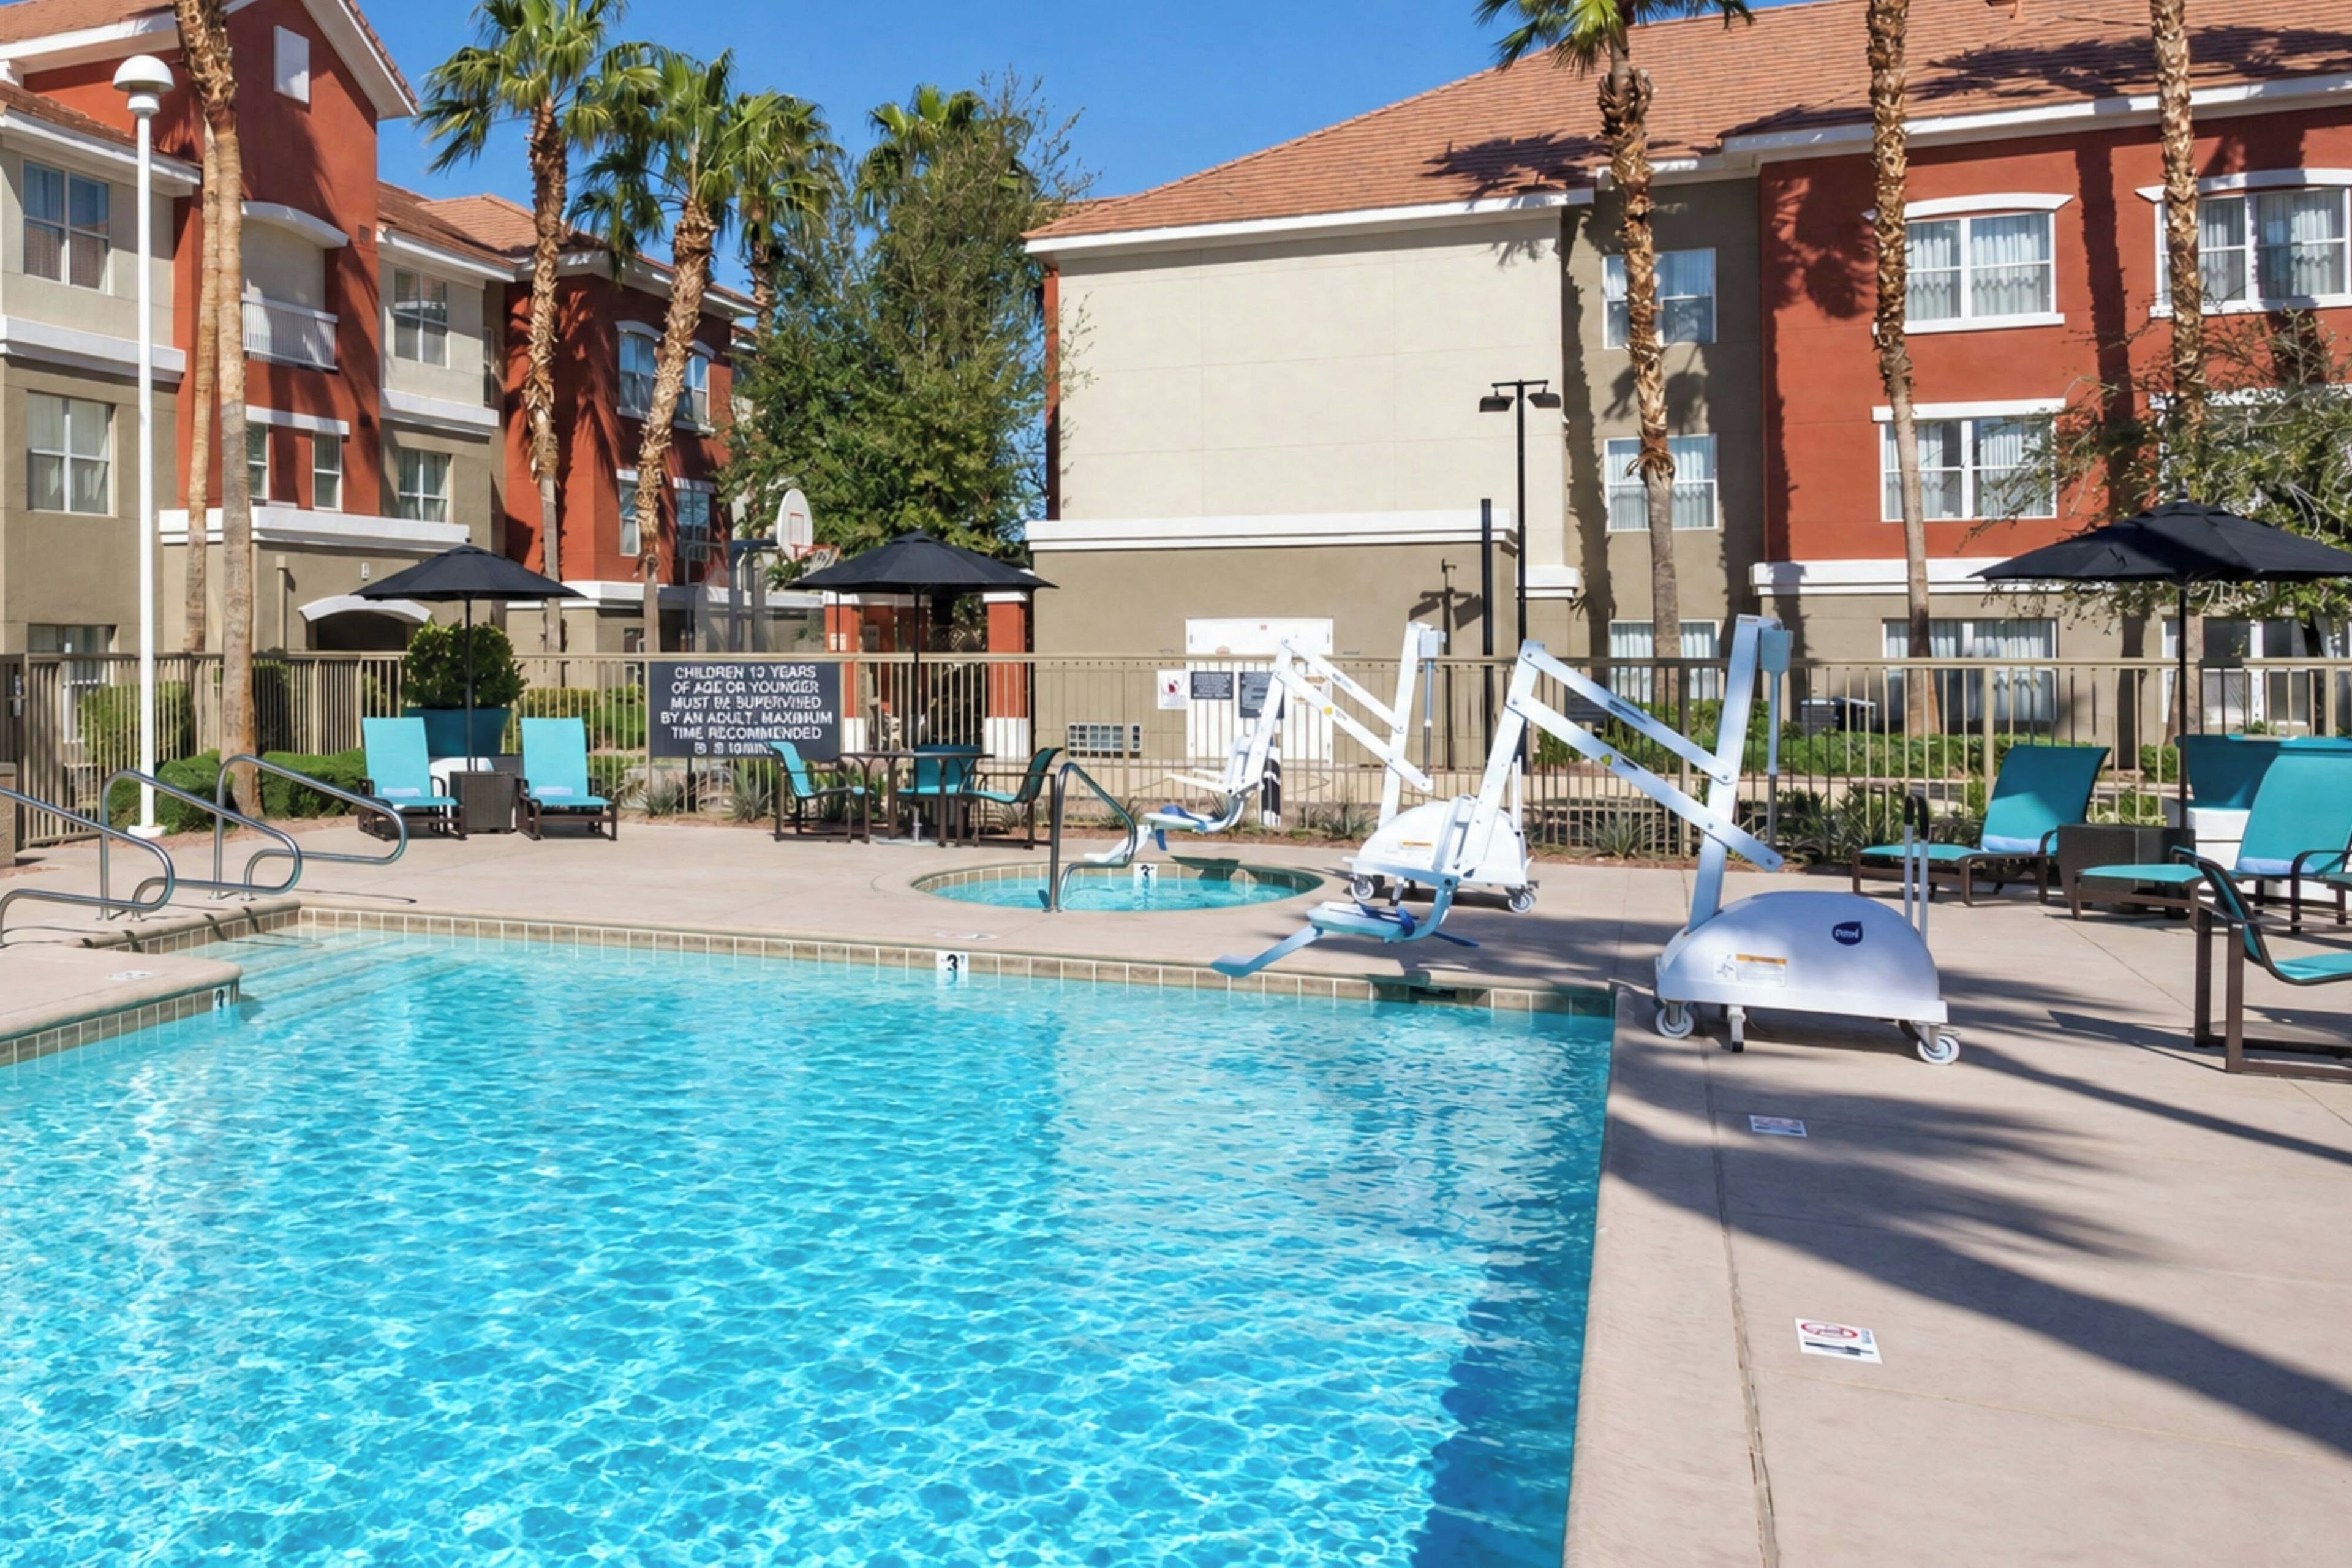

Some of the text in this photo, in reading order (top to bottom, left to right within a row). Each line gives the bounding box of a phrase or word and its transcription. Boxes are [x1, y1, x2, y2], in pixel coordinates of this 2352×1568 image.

[674, 666, 744, 679] CHILDREN
[769, 665, 816, 678] YEARS
[671, 680, 820, 695] OF AGE OR YOUNGER
[671, 696, 710, 709] MUST
[736, 695, 822, 709] SUPERVISED
[660, 712, 679, 724] BY
[683, 712, 703, 724] AN
[761, 711, 833, 724] MAXIMUM
[671, 726, 823, 739] TIME RECOMMENDED
